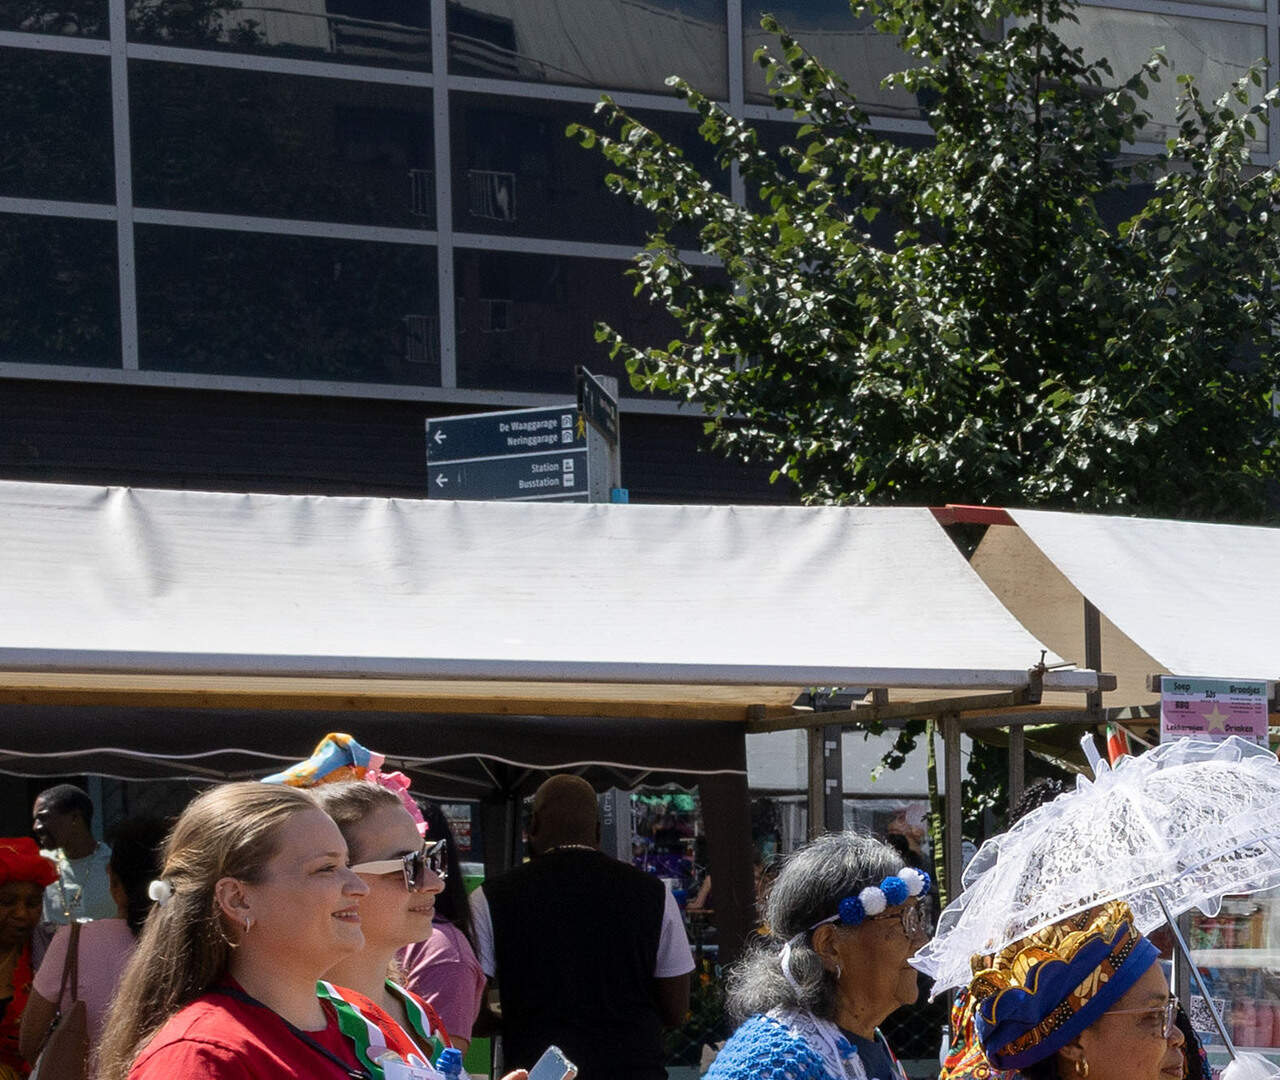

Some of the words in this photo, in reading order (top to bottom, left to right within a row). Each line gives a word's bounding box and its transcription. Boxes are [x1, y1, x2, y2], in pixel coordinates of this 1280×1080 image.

[500, 423, 509, 433] De
[510, 419, 558, 432] Waaggarage
[507, 432, 558, 446] Neringgarage
[531, 463, 559, 473] Station
[519, 477, 559, 489] Busstation
